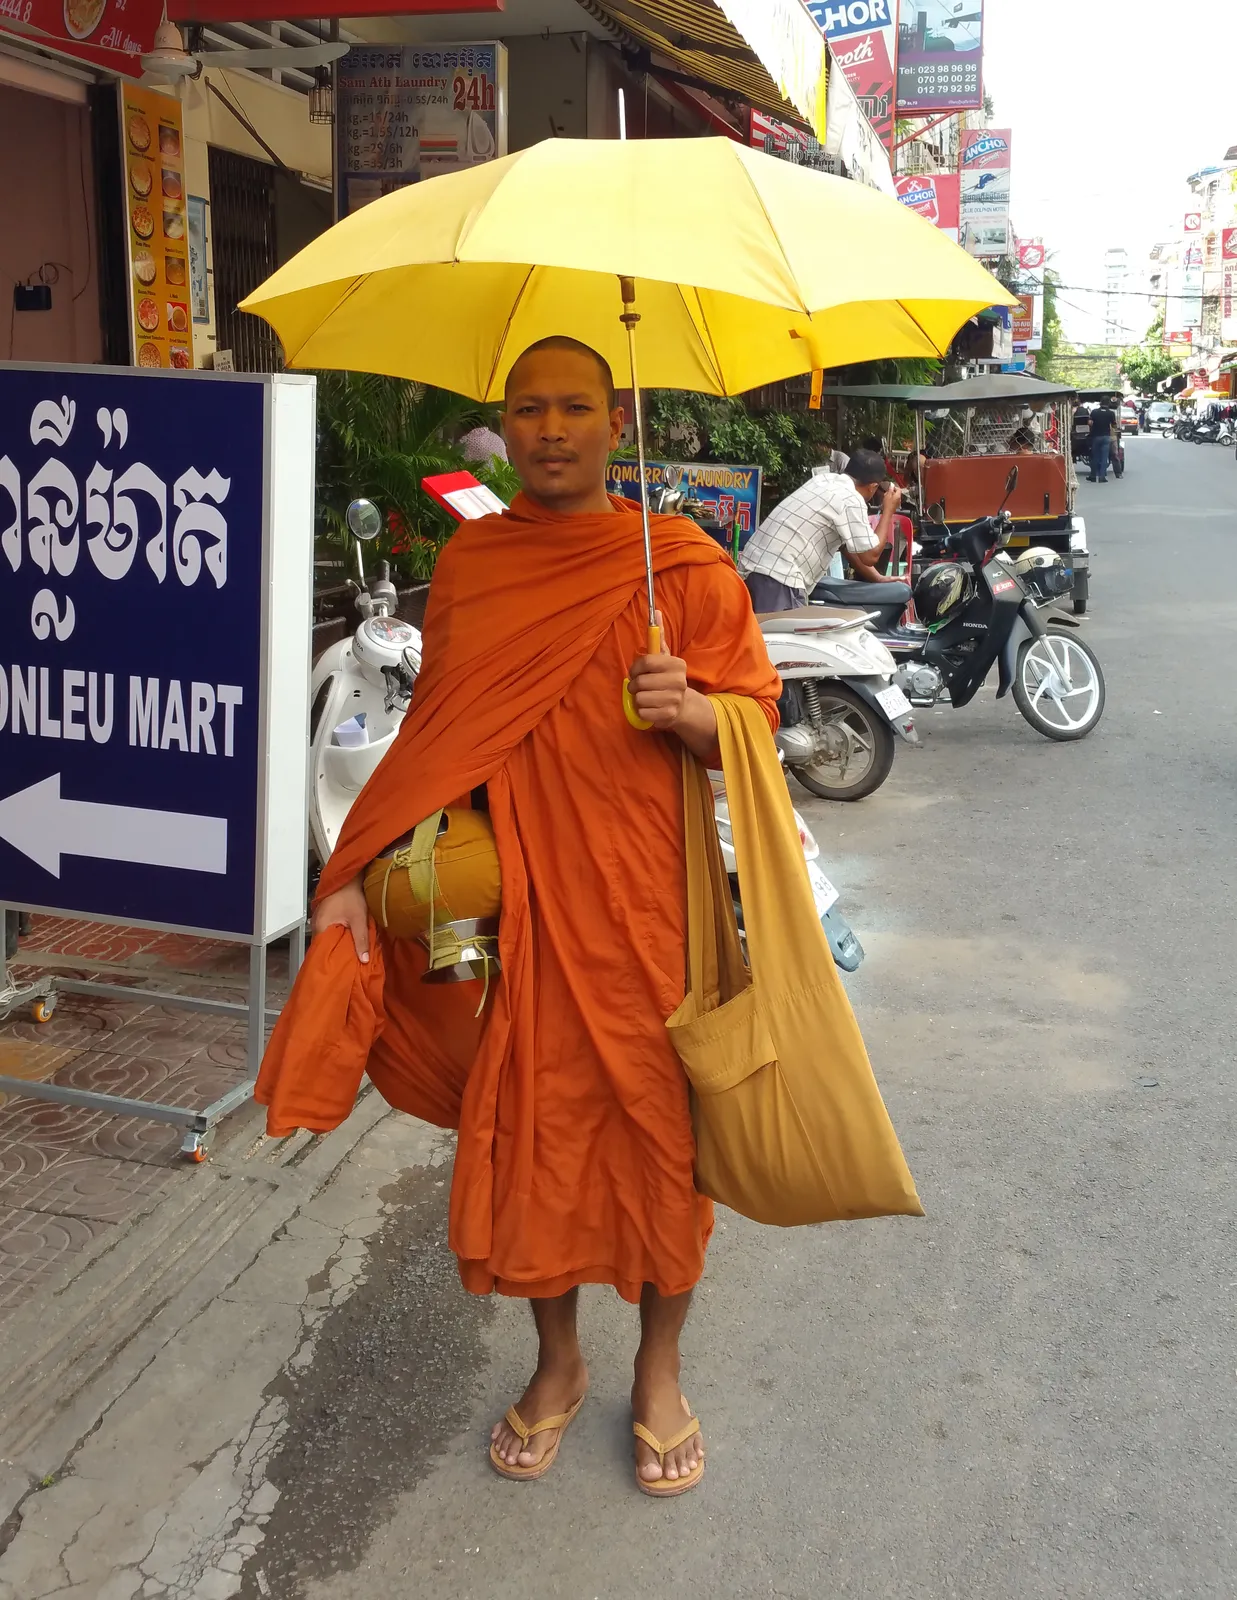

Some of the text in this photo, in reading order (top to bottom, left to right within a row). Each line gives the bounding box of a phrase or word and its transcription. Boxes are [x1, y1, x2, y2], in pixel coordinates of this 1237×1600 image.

[100, 27, 121, 48] All
[899, 63, 977, 75] Tel: 023 98 96 96
[339, 76, 448, 90] Sam Ath Laundry
[917, 74, 977, 84] 070 90 00 22
[453, 73, 495, 111] 24h
[917, 84, 977, 94] 012 79 92 95
[965, 139, 1007, 161] ANCHOR
[898, 191, 935, 204] ANCHOR
[688, 469, 753, 489] LAUNDRY
[129, 675, 243, 757] MART
